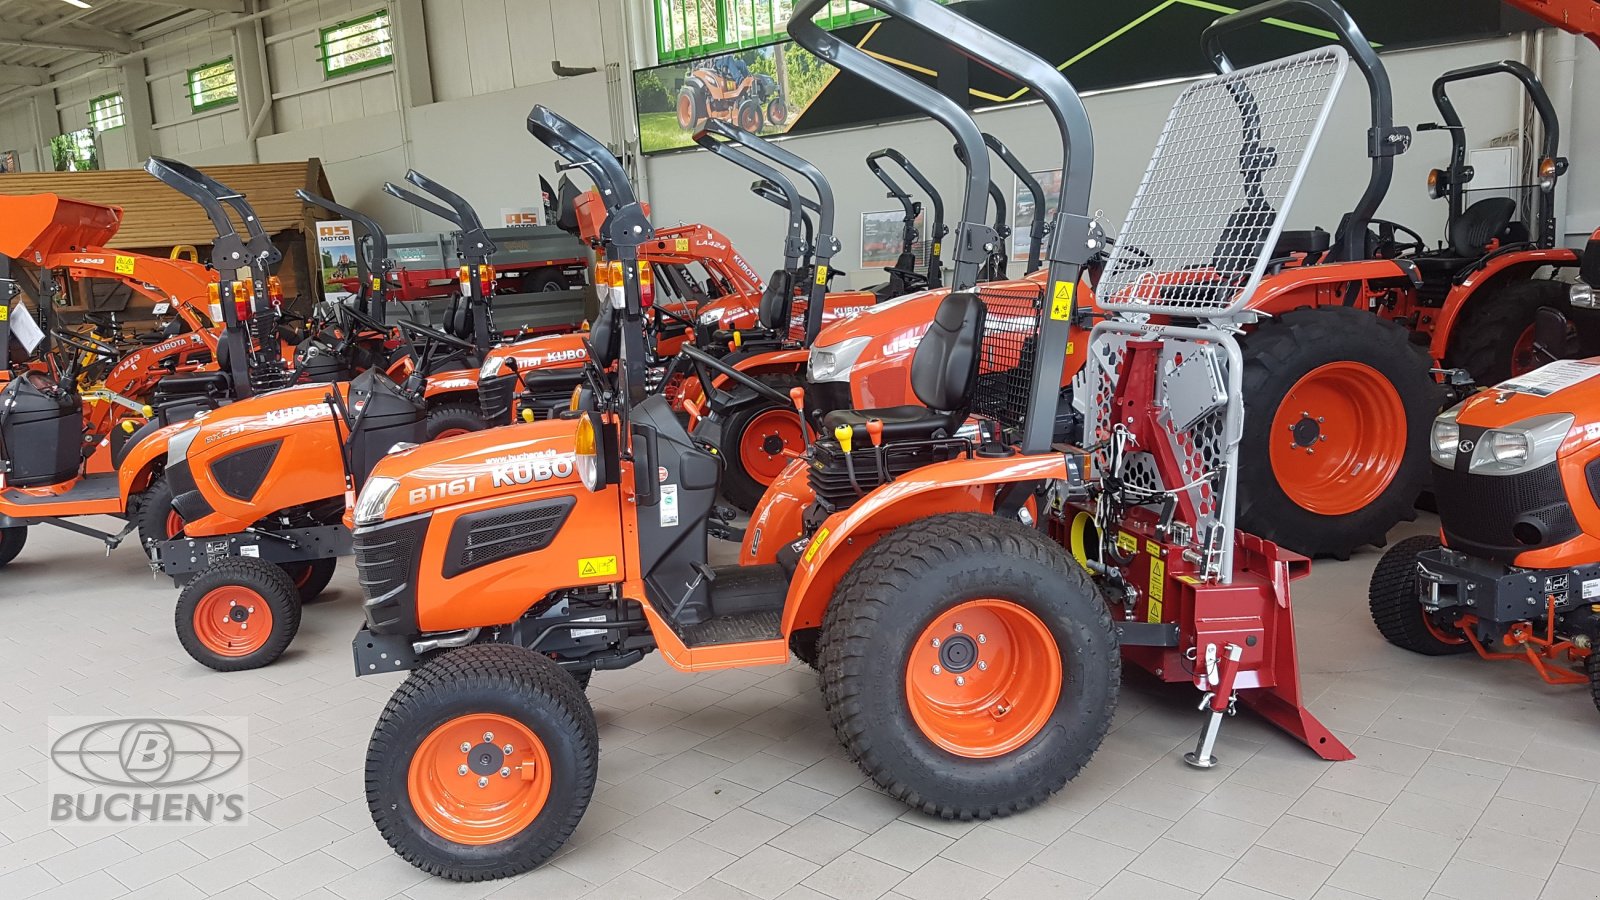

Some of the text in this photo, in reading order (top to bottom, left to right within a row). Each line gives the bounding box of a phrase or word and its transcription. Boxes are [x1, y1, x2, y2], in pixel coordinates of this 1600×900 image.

[319, 226, 350, 236] AS
[696, 240, 726, 250] LA424
[733, 255, 759, 283] KUBOTA
[152, 338, 187, 354] KUBOTA
[547, 349, 587, 361] KUBO
[113, 353, 141, 379] LA213
[409, 456, 577, 506] B1161 KUBO
